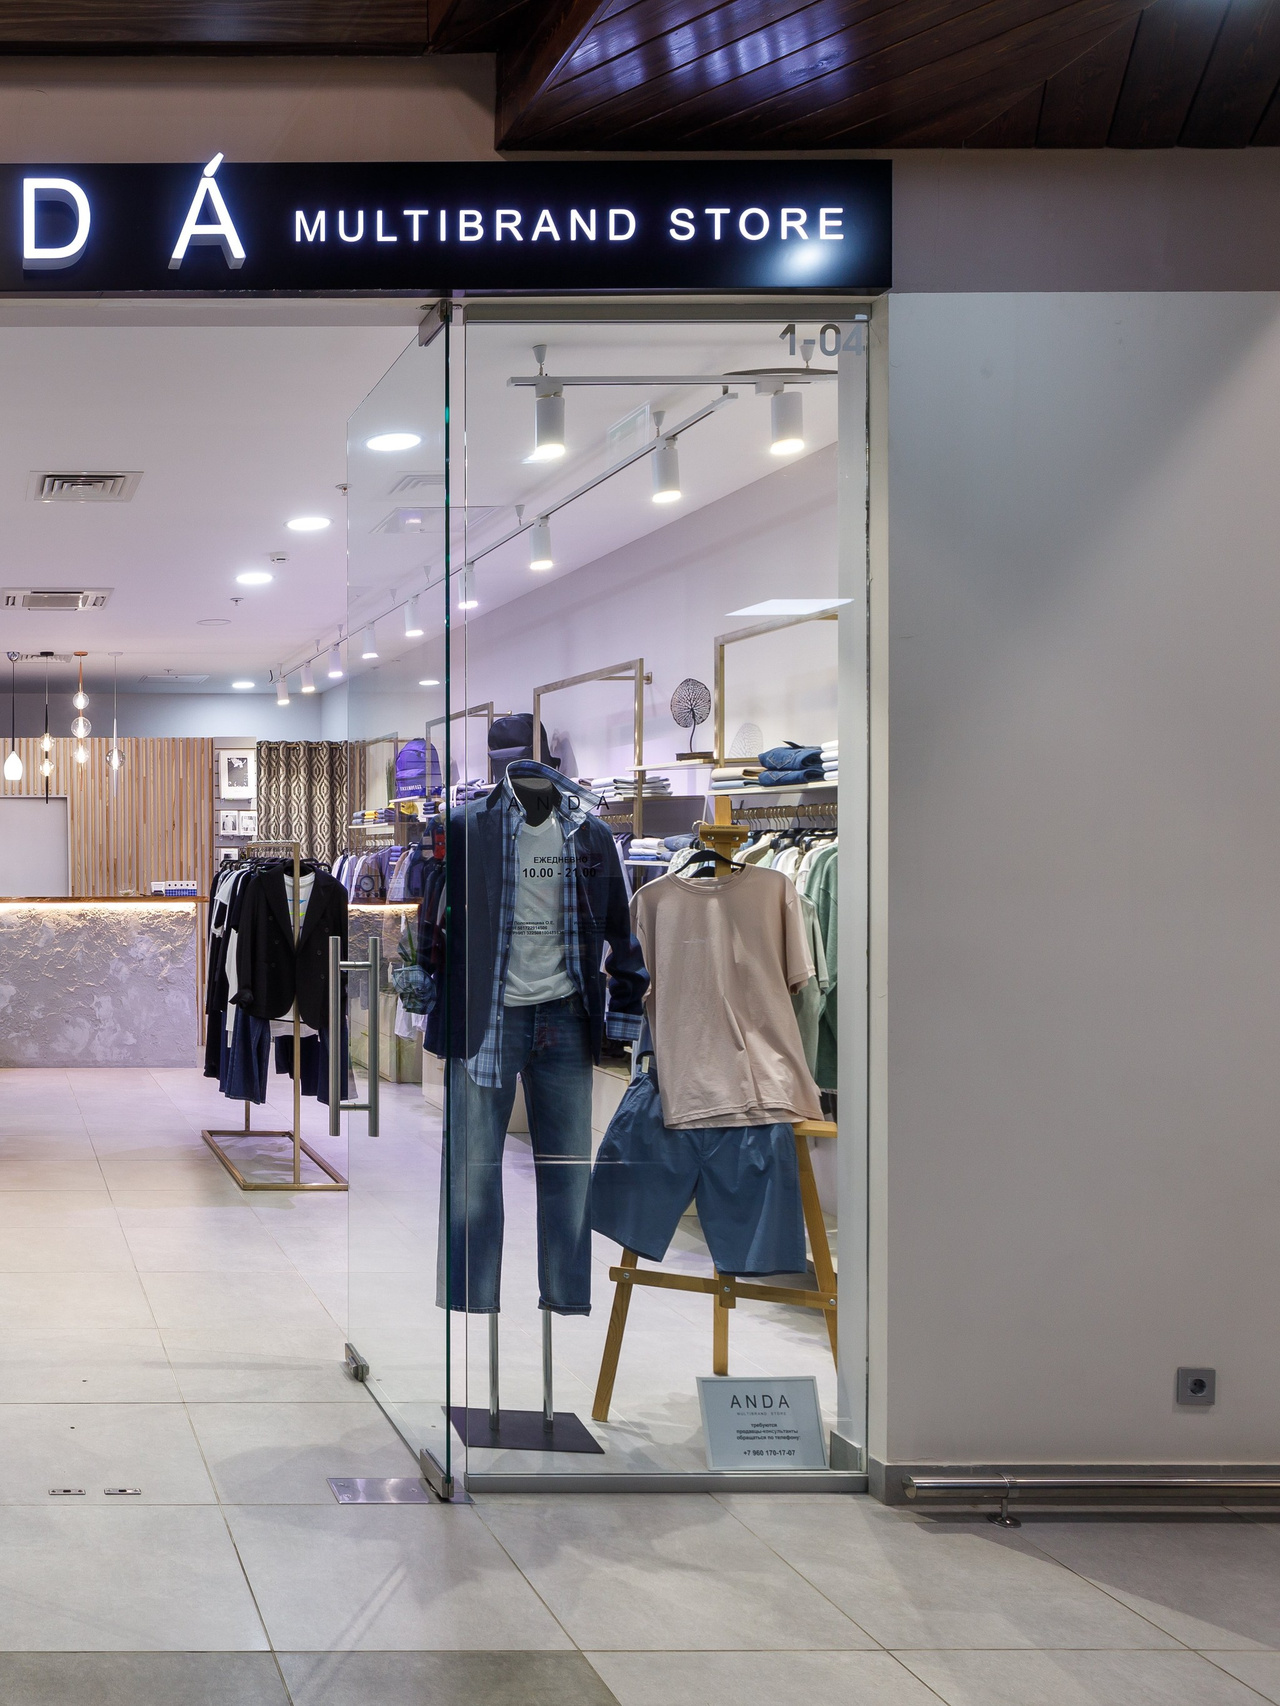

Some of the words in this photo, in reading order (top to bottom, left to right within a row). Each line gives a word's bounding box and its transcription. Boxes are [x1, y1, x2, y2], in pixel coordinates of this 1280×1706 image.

[294, 209, 636, 242] MULTIBRAND
[669, 208, 844, 241] STORE
[778, 323, 866, 356] 1-04
[533, 856, 588, 864] ЕЖЕДНЕВНО
[522, 867, 554, 878] 10.00
[565, 867, 596, 878] 21.00
[730, 1394, 790, 1409] ANDA
